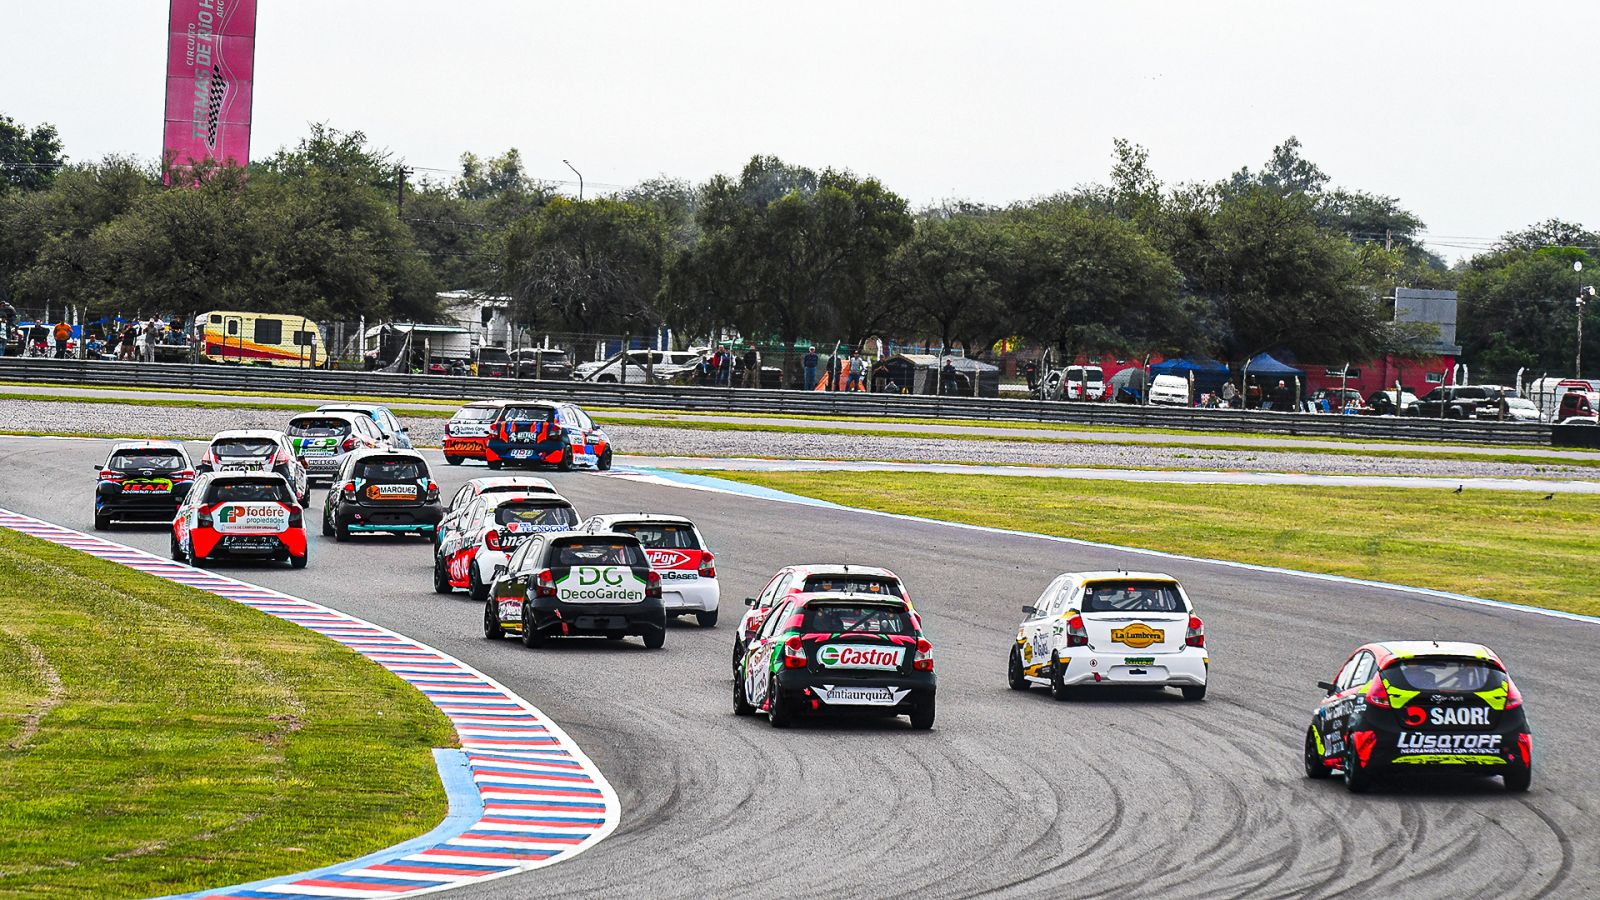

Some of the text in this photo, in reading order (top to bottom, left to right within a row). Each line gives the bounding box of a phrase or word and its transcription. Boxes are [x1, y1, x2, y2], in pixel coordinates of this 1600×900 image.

[186, 22, 196, 66] CIRCUITO
[196, 43, 212, 67] DE
[192, 68, 211, 140] TERMAS
[380, 486, 416, 494] MARQUEZ
[246, 505, 284, 517] fodéré
[520, 523, 570, 533] TECNOCOM
[561, 588, 643, 600] DecoGarden
[840, 647, 899, 666] Castrol
[1430, 706, 1491, 725] SAORI
